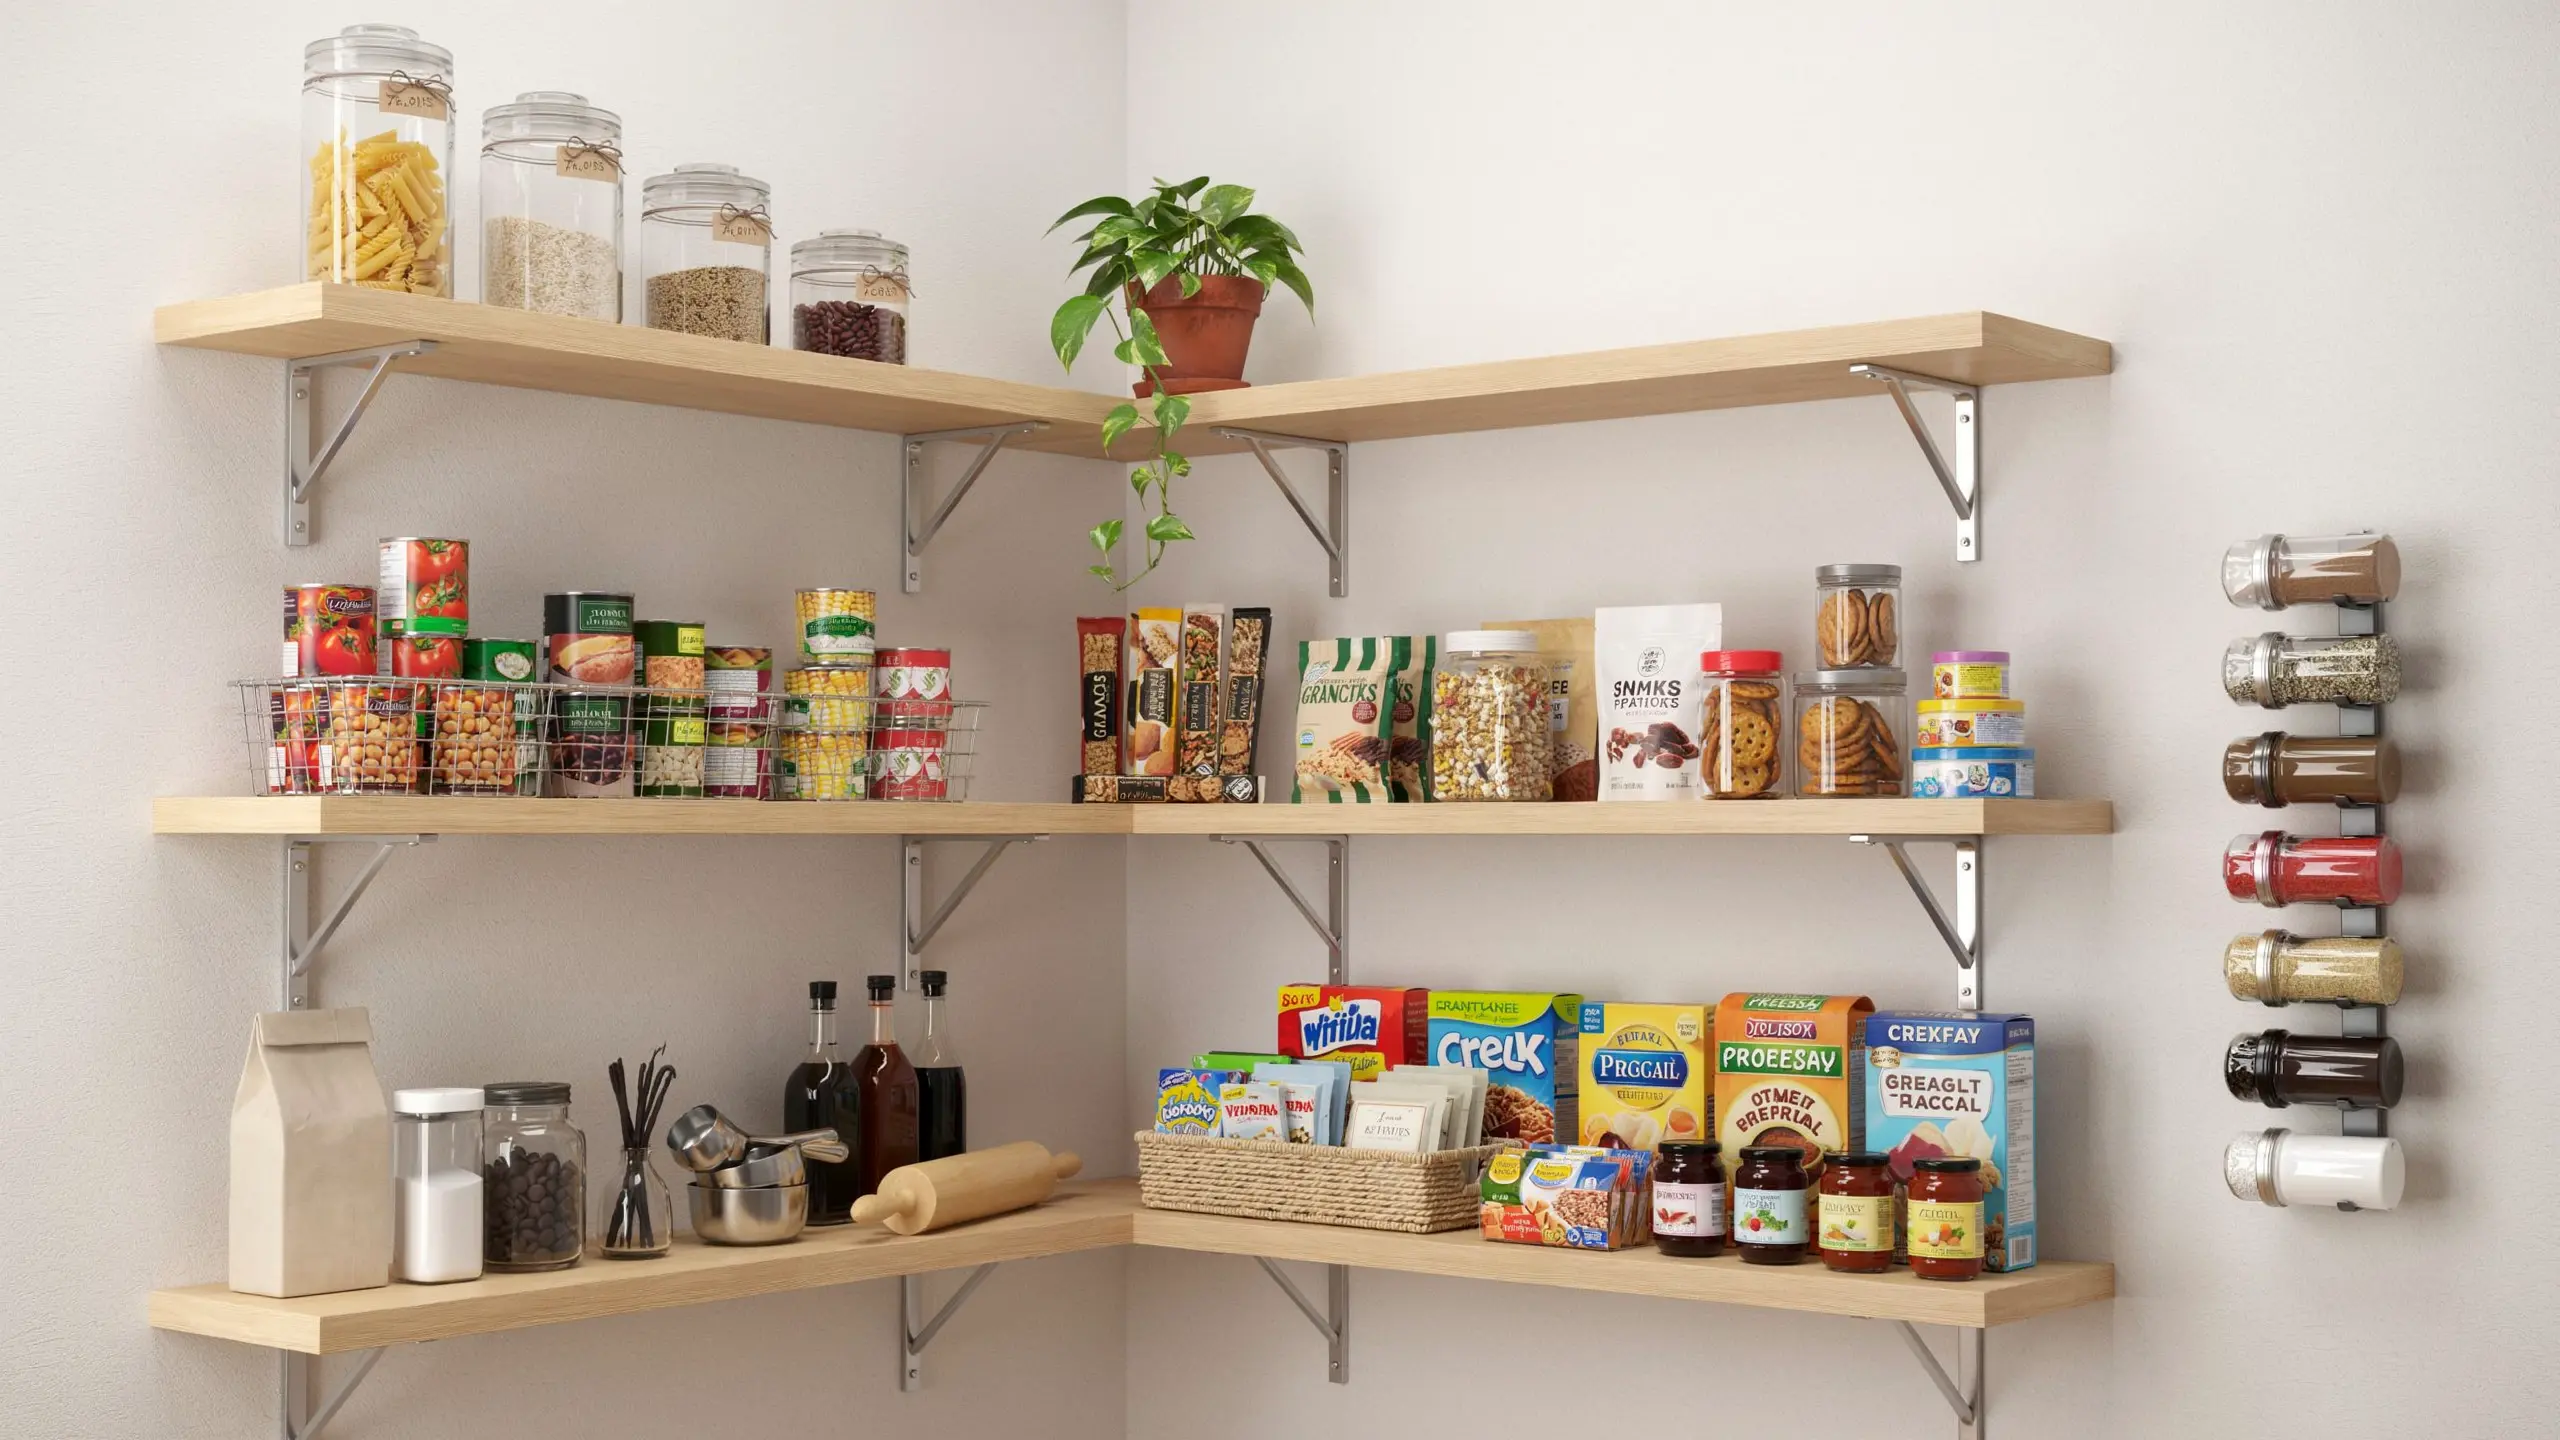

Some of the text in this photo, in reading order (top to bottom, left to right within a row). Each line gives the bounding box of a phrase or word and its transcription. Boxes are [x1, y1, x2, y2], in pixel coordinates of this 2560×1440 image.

[1888, 1024, 1981, 1044] CREXFAY
[1723, 1046, 1836, 1073] PROEESAY
[1885, 1074, 1981, 1095] GREAGLT
